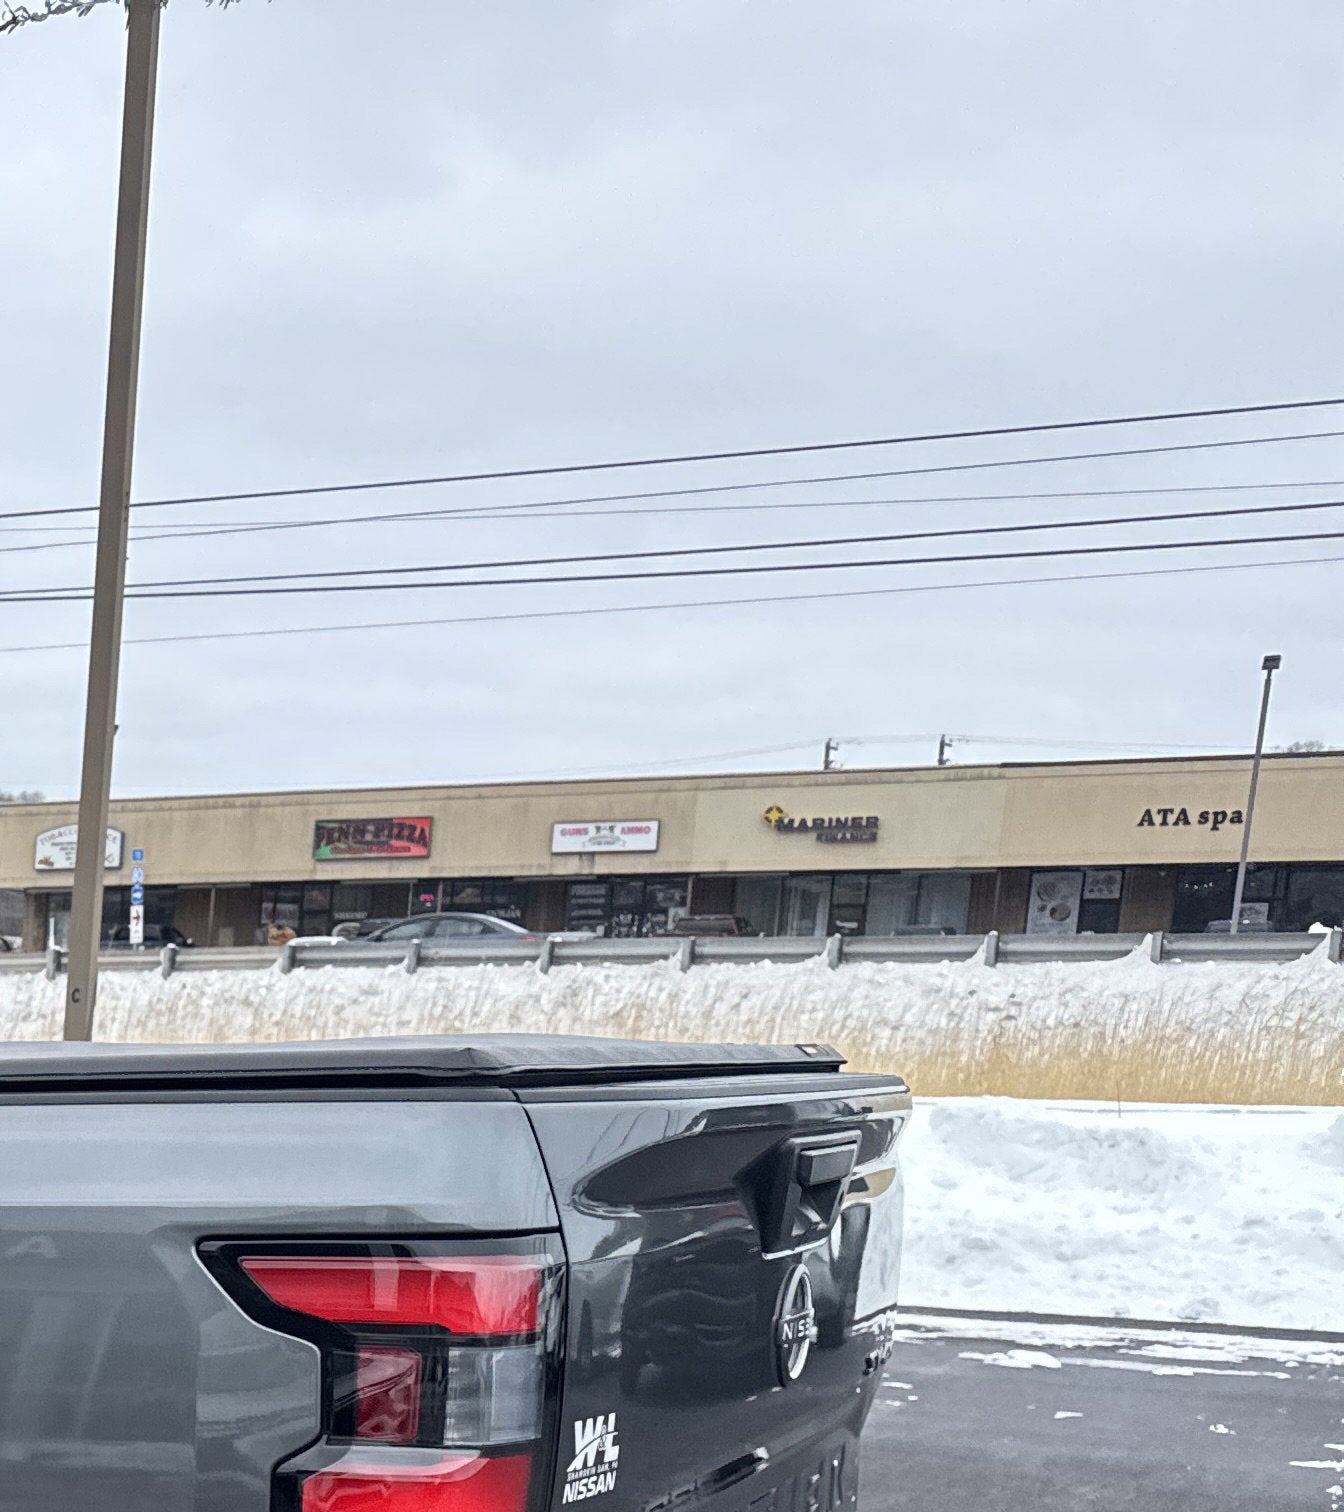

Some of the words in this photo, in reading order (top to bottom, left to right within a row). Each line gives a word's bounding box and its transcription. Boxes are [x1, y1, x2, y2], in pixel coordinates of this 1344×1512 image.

[776, 816, 879, 832] MARINER
[1137, 808, 1191, 826] ATA
[1198, 809, 1244, 831] spa
[621, 825, 651, 835] AMMO
[562, 1470, 617, 1504] NISSAN
